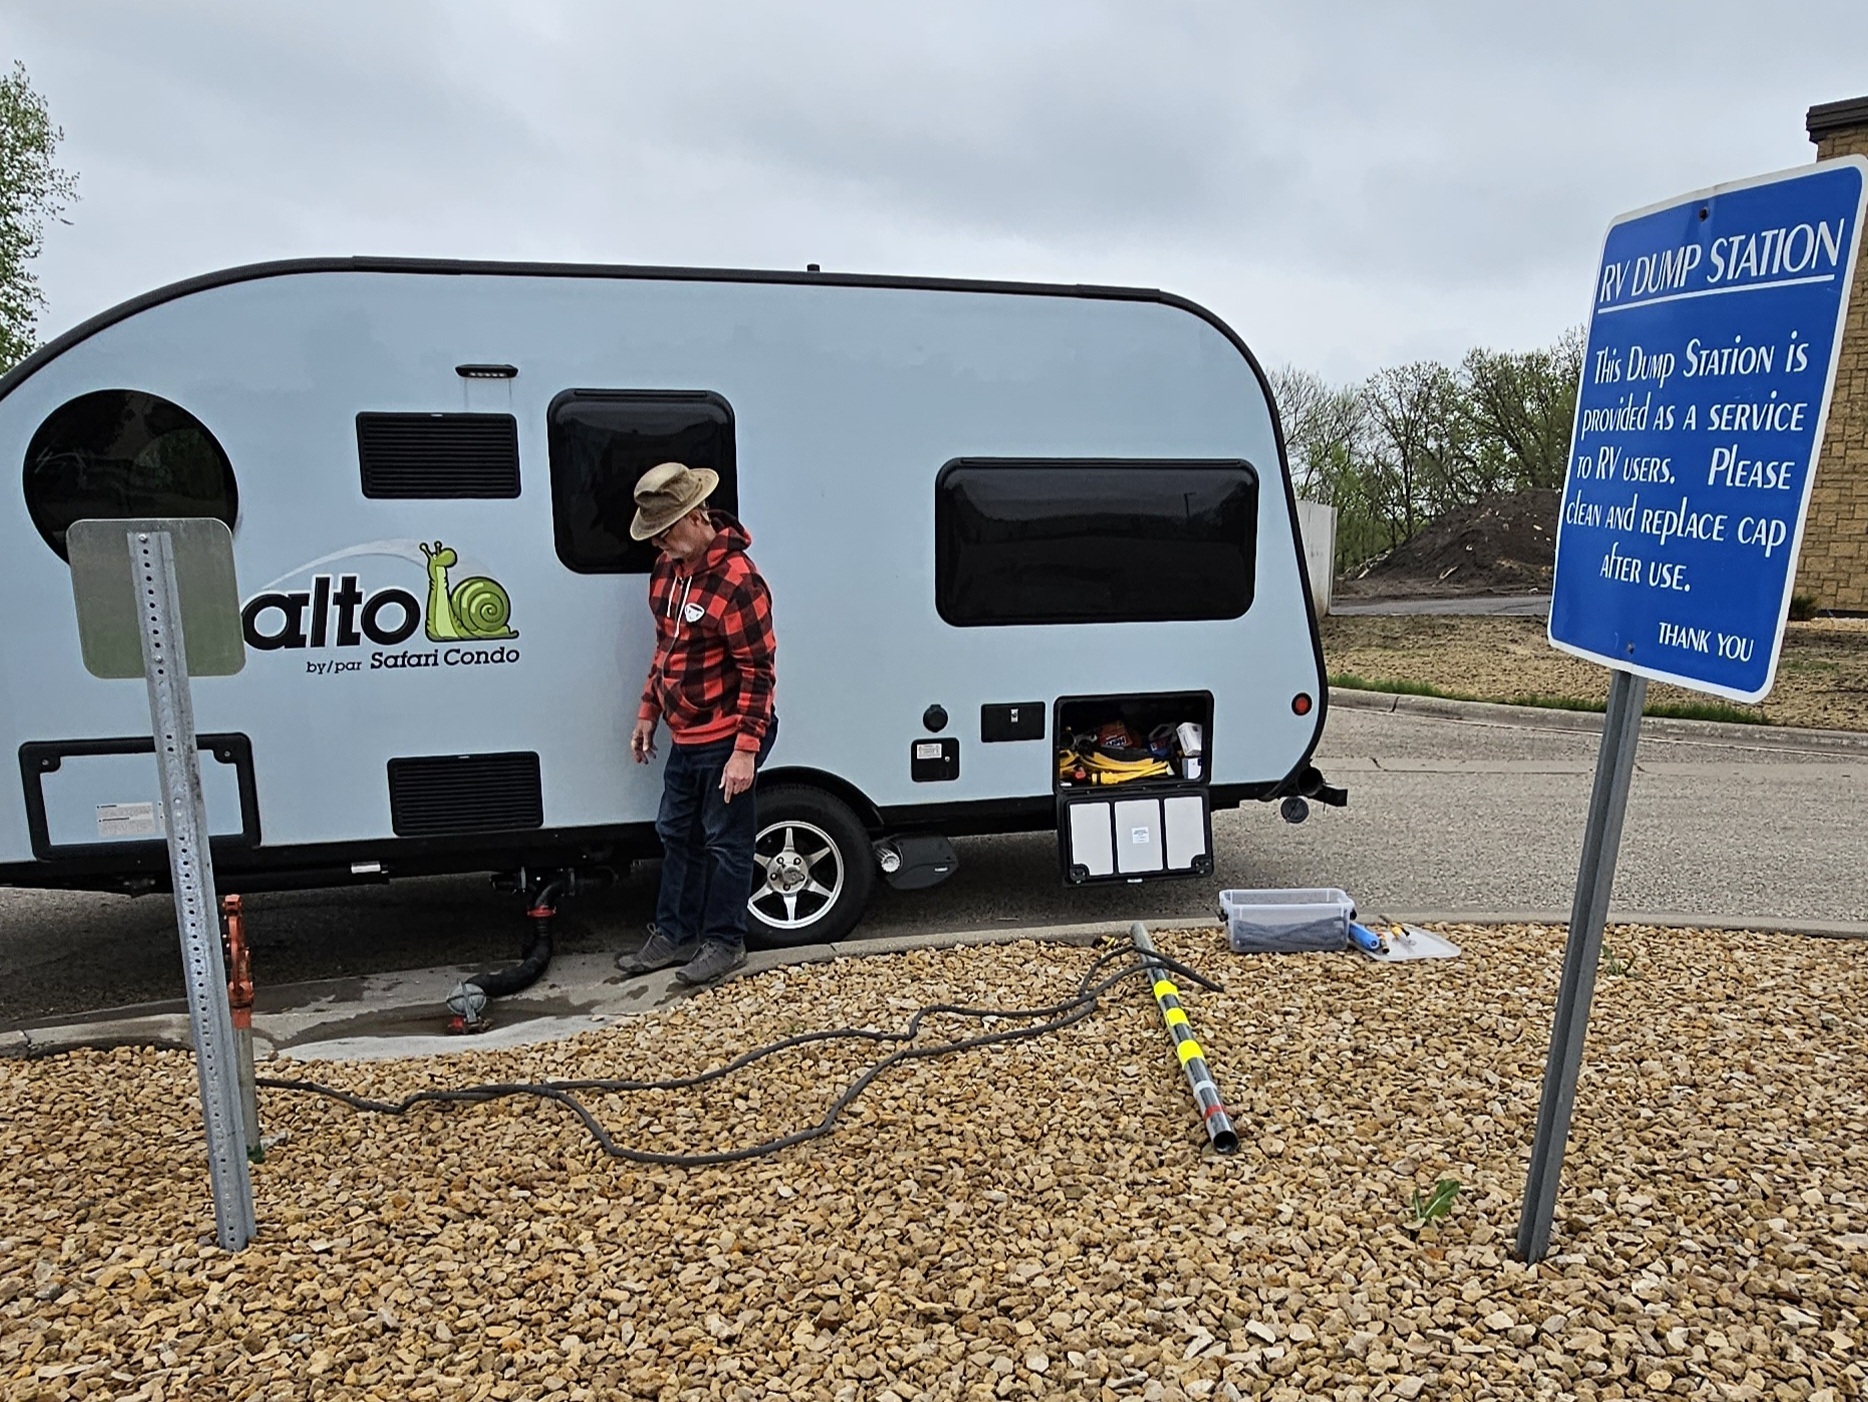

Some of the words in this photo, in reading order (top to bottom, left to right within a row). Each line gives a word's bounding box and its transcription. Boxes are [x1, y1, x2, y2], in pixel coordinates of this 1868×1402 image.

[1600, 260, 1631, 303] RV
[1631, 243, 1702, 298] DUMP
[1706, 218, 1845, 284] STATION
[1595, 446, 1622, 480] RV
[242, 576, 421, 651] alto
[306, 660, 362, 675] by/par
[370, 649, 439, 670] Safari
[443, 646, 520, 667] Condo
[1659, 622, 1712, 654] THANK
[1717, 632, 1754, 662] YOU
